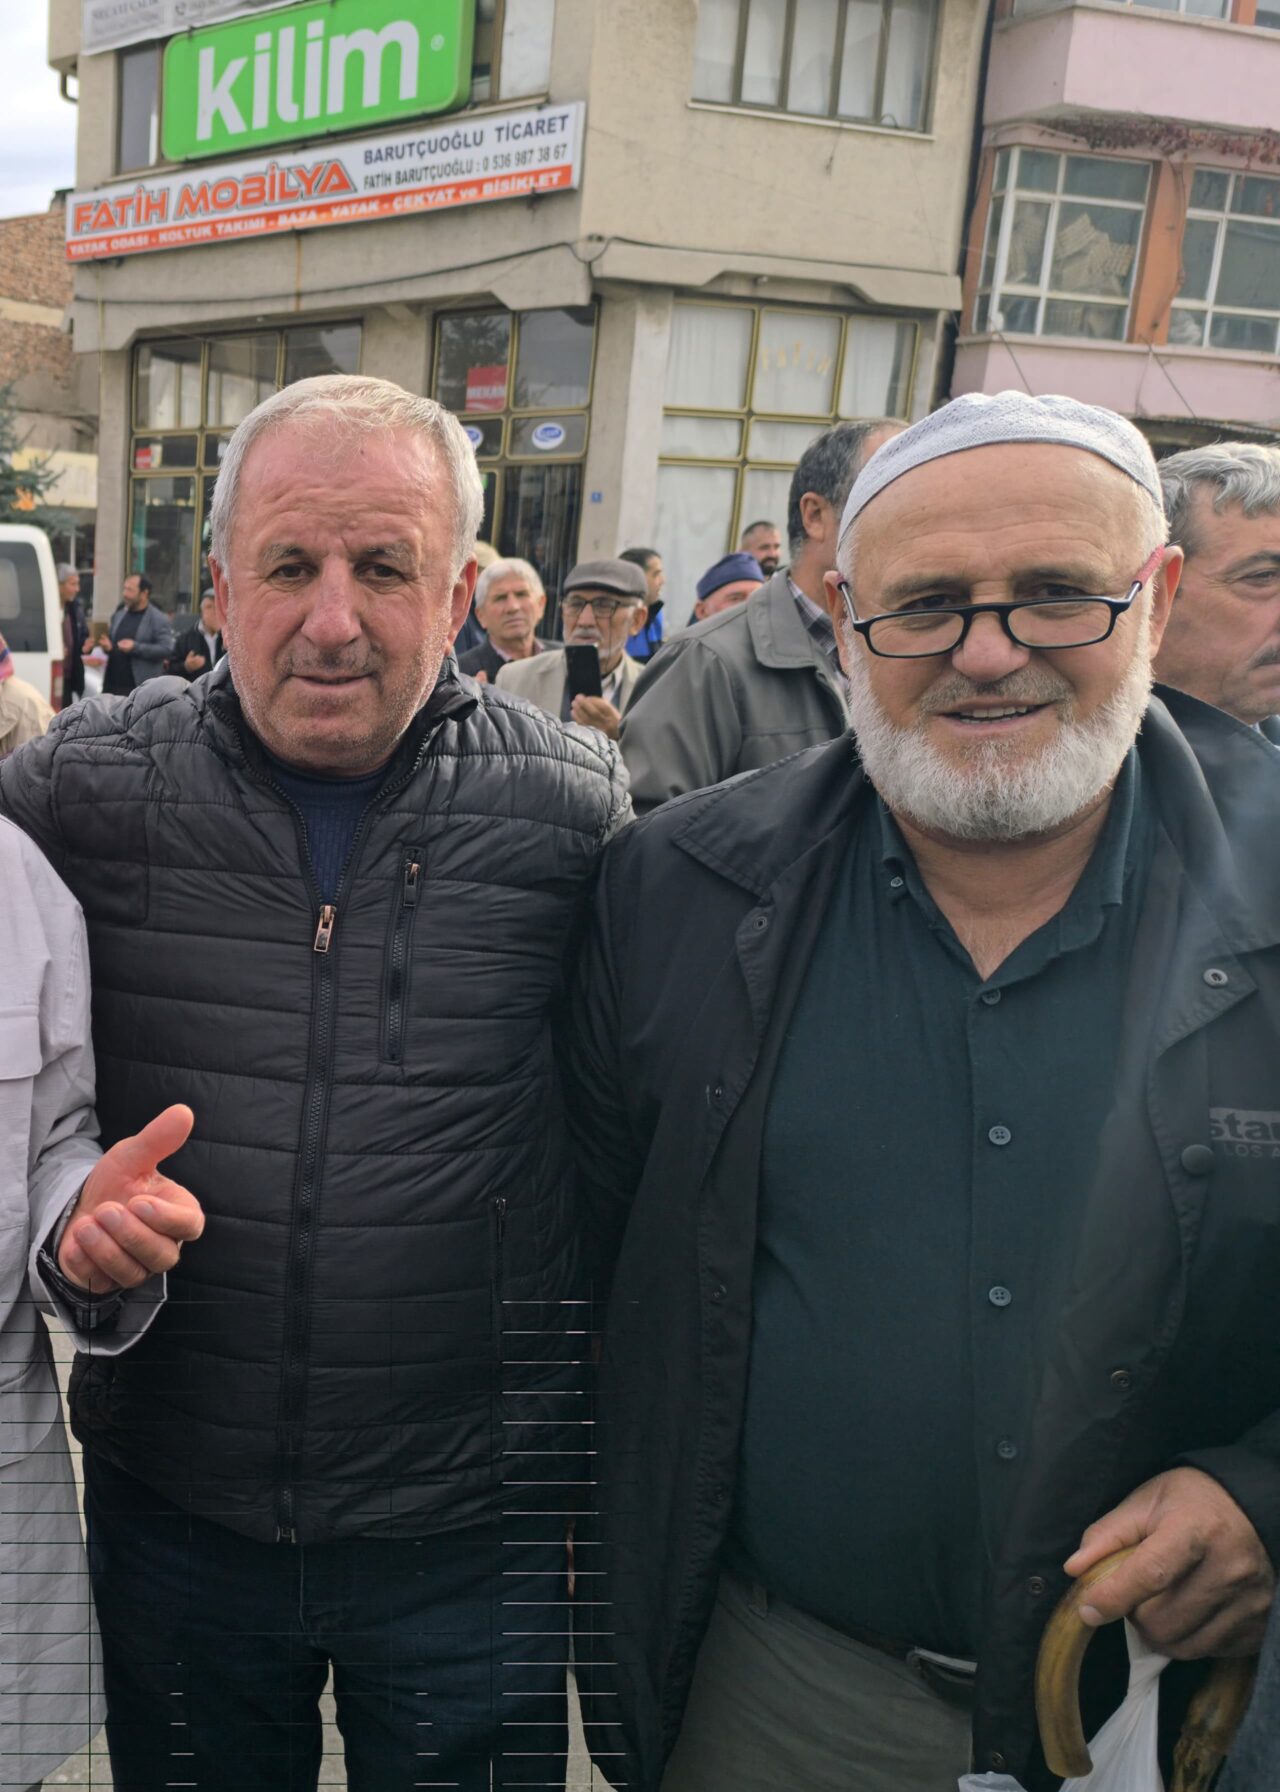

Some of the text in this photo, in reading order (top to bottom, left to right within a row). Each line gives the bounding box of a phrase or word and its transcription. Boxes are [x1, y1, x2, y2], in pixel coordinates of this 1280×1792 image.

[196, 19, 419, 141] kilim
[363, 114, 570, 166] BARUTÇUOĞLU TİCARET
[395, 158, 474, 186] BARUTÇUOĞLU
[553, 143, 568, 161] 67
[70, 240, 107, 256] YATAK
[158, 225, 213, 242] KOLTUK
[216, 216, 267, 235] TAKIMI
[278, 208, 318, 227] BAZA
[331, 199, 380, 218] YATAK
[392, 187, 455, 213] ÇEKYAT
[482, 170, 562, 195] BİSİKLET
[72, 159, 358, 236] FATİH MOBİLYA
